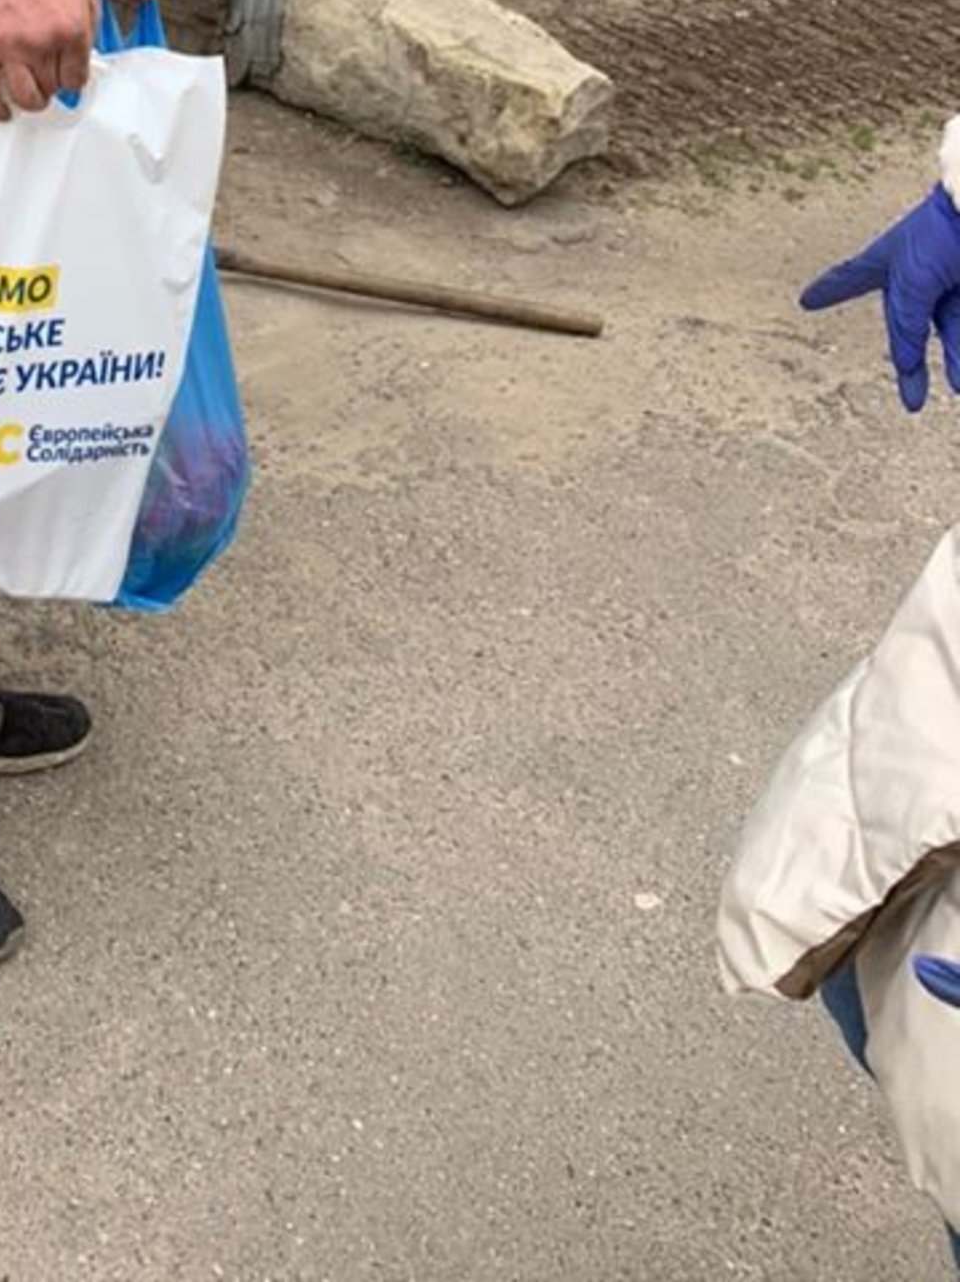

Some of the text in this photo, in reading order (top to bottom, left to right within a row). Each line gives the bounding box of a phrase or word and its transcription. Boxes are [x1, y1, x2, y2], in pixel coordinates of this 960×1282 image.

[15, 350, 166, 392] УКРАЇНИ!
[28, 421, 154, 445] Європейська
[26, 441, 151, 464] Солідарність
